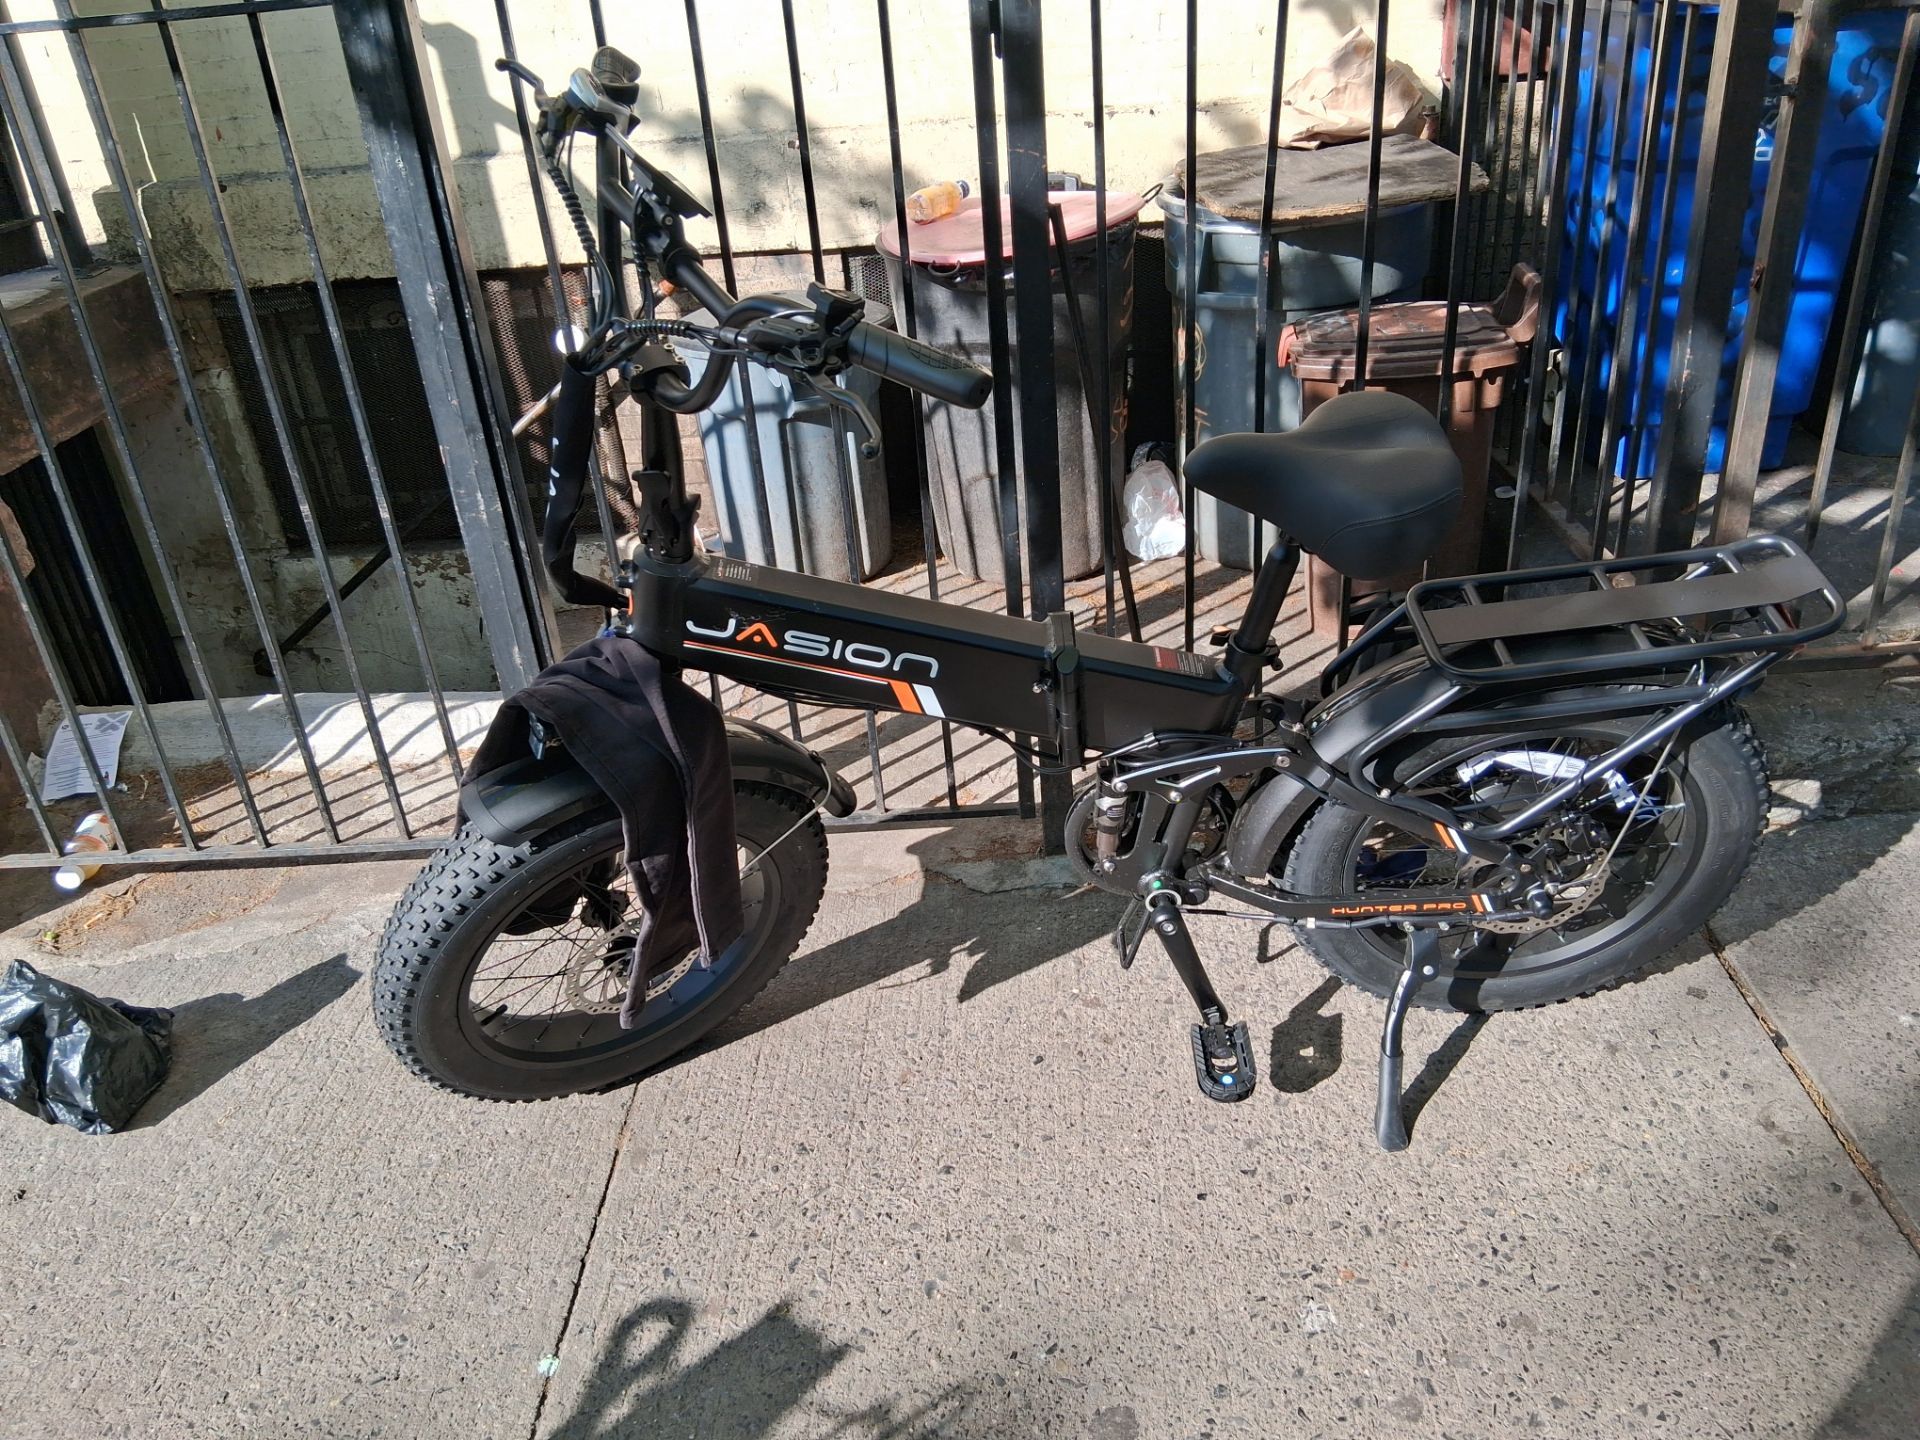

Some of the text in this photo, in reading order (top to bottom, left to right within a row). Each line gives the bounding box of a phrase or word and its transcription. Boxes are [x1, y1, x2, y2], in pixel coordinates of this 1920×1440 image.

[686, 618, 939, 678] JASION
[1332, 902, 1467, 915] HUNTER PRO
